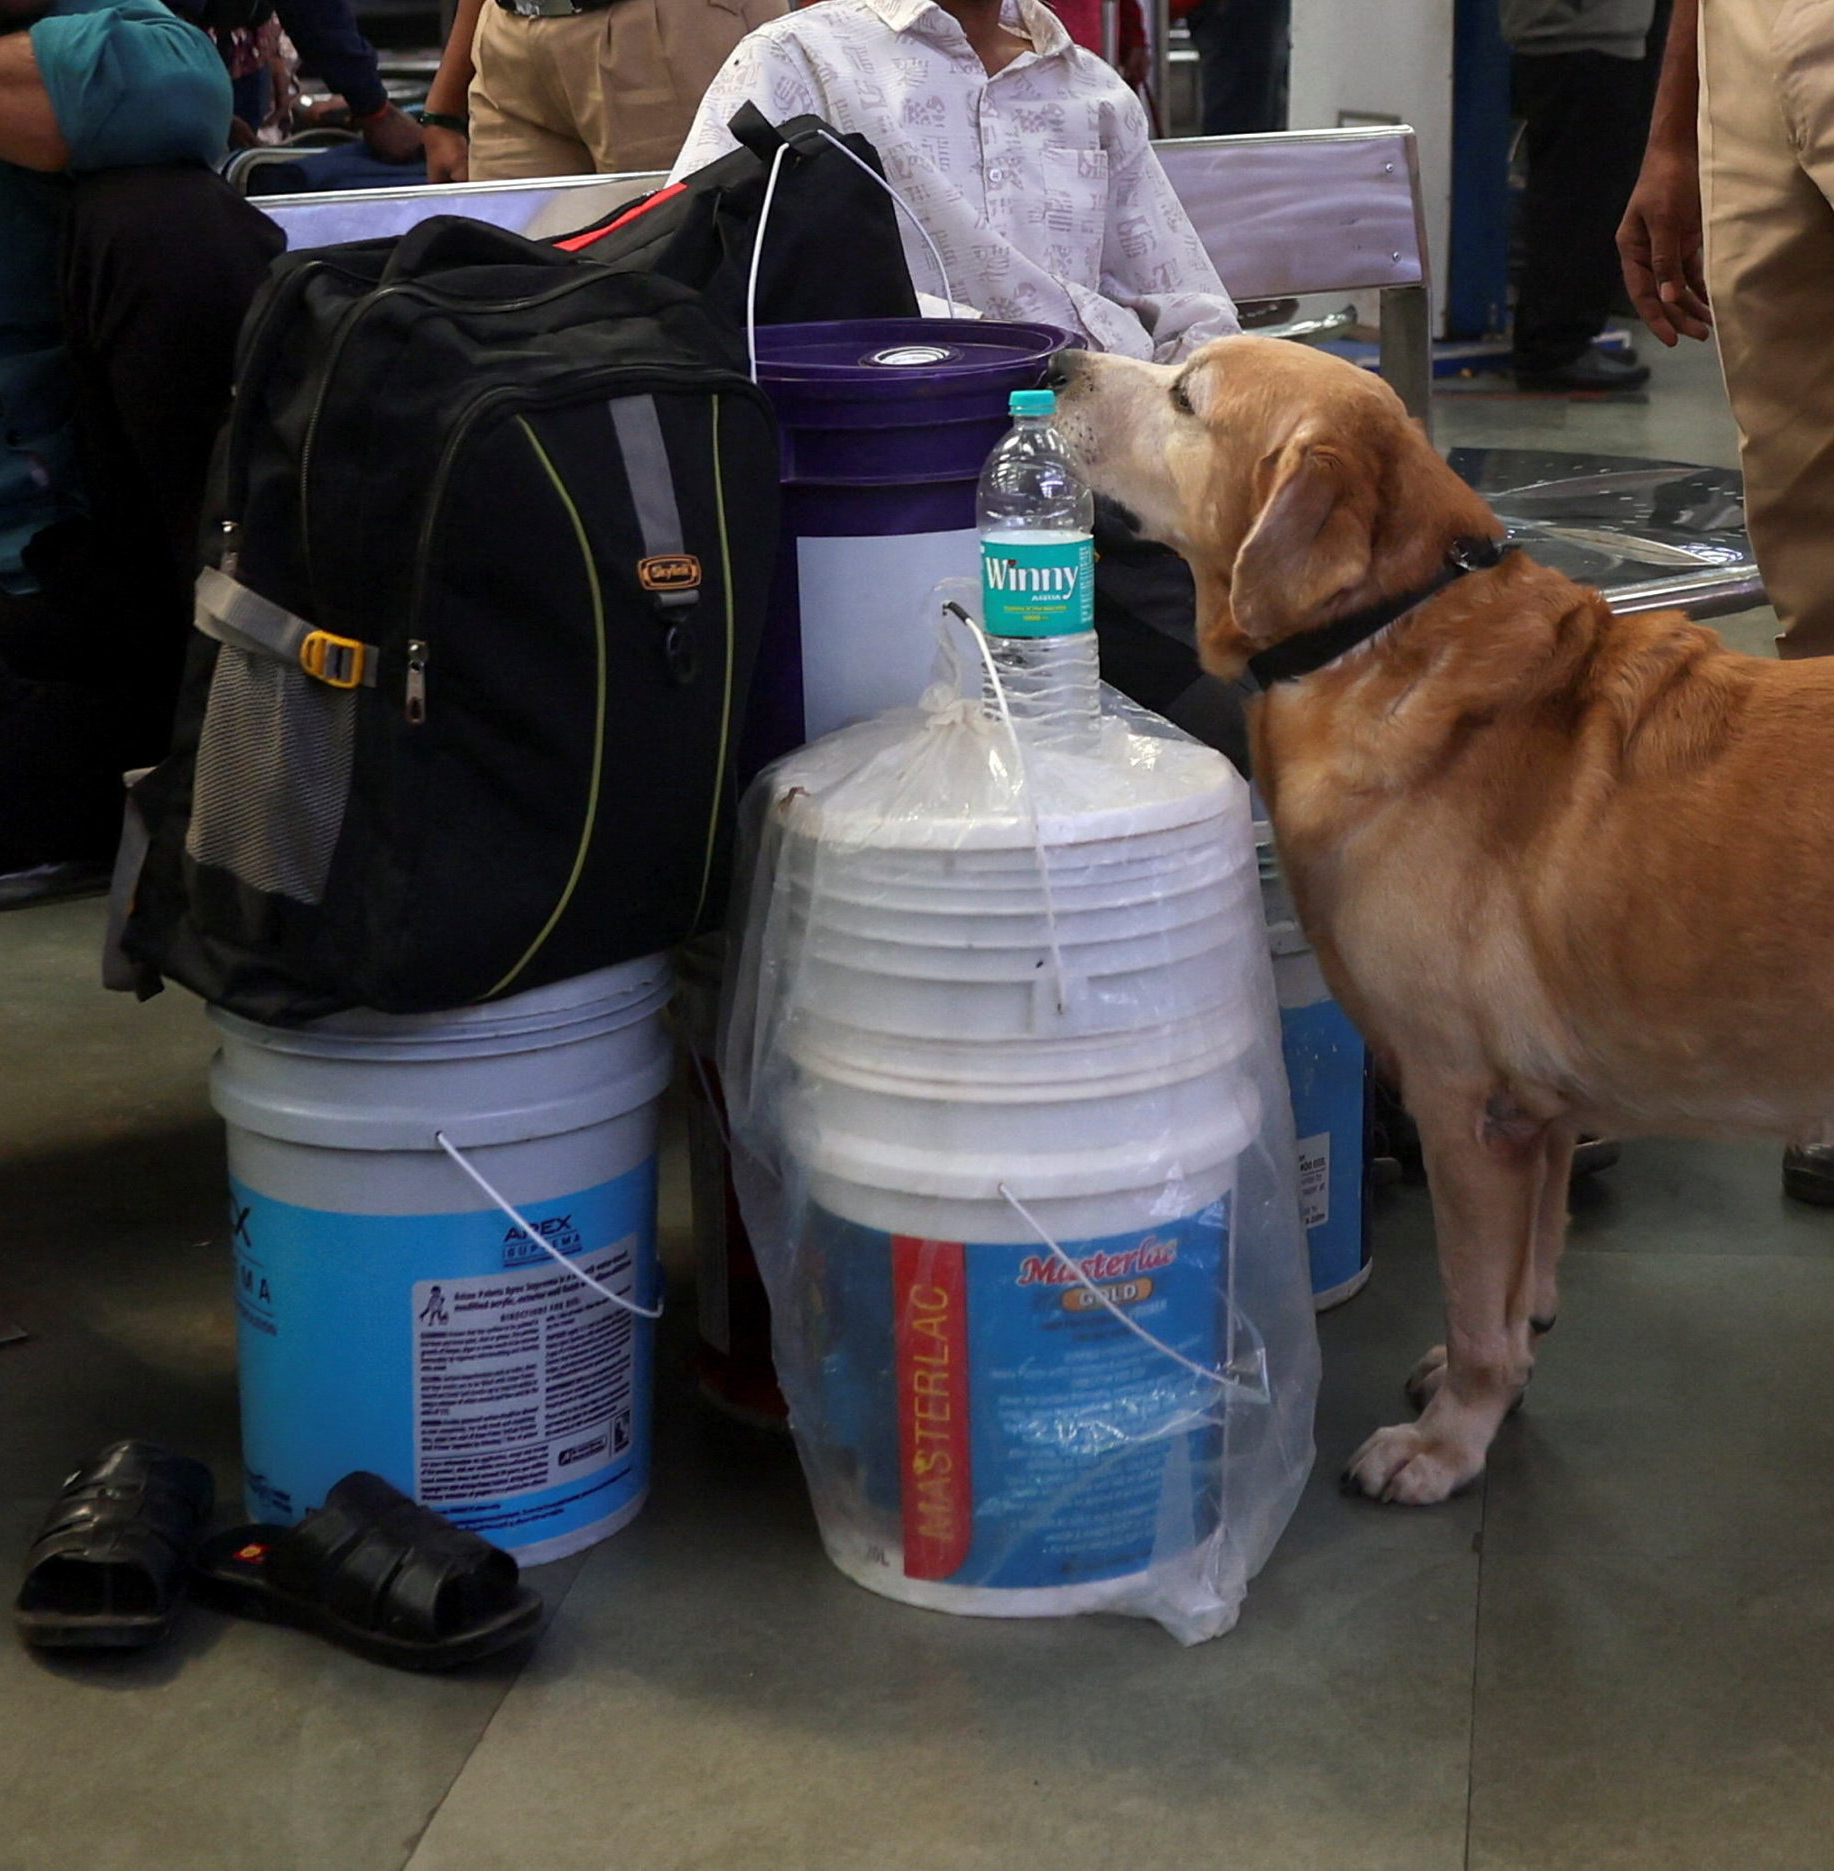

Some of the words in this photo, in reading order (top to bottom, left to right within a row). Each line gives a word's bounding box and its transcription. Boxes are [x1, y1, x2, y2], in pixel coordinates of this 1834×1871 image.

[985, 556, 1079, 600] Winny
[507, 1233, 581, 1258] SUPEMA
[1078, 1284, 1137, 1306] GOLD
[910, 1284, 955, 1542] MASTERLAC
